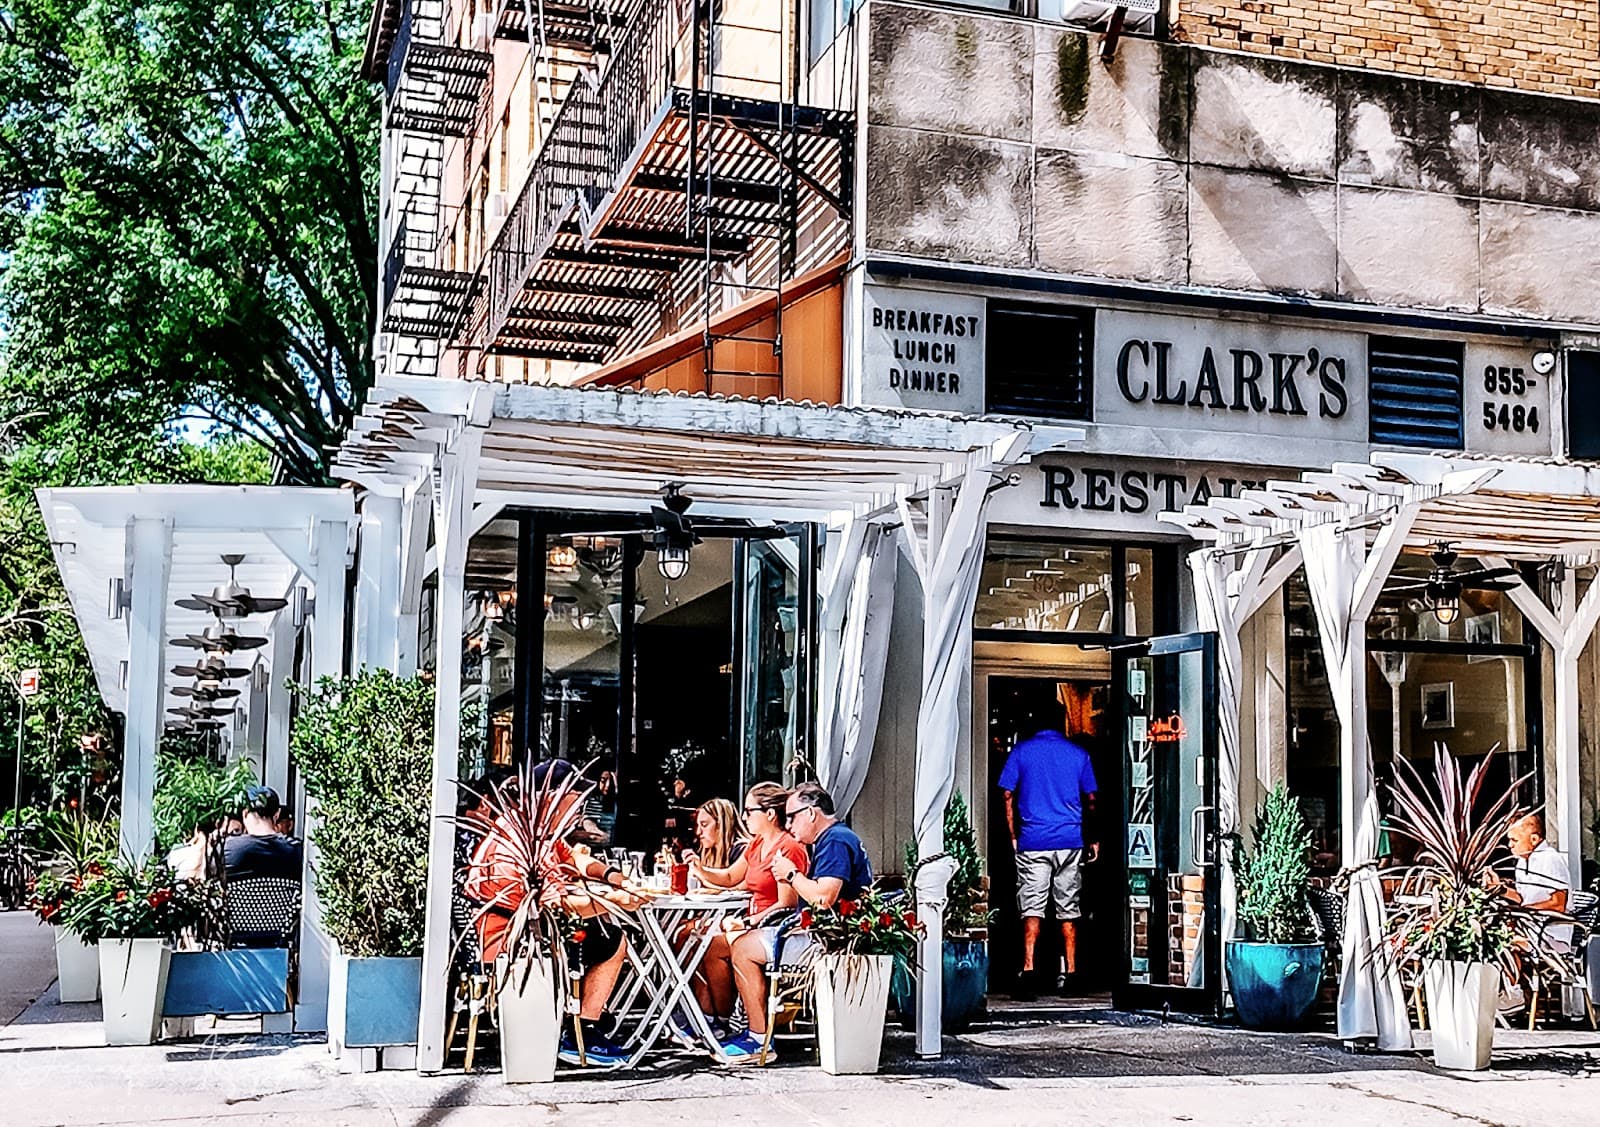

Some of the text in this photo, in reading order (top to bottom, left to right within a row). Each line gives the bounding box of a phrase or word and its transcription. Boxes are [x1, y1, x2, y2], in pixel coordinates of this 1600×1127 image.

[873, 307, 979, 338] BREAKFAST
[893, 339, 956, 364] LUNCH
[889, 367, 960, 395] DINNER
[1117, 338, 1348, 419] CLARK'S
[1484, 365, 1537, 396] 855-
[1483, 402, 1540, 433] 5484
[1039, 464, 1268, 514] RESTA
[1129, 829, 1151, 856] A
